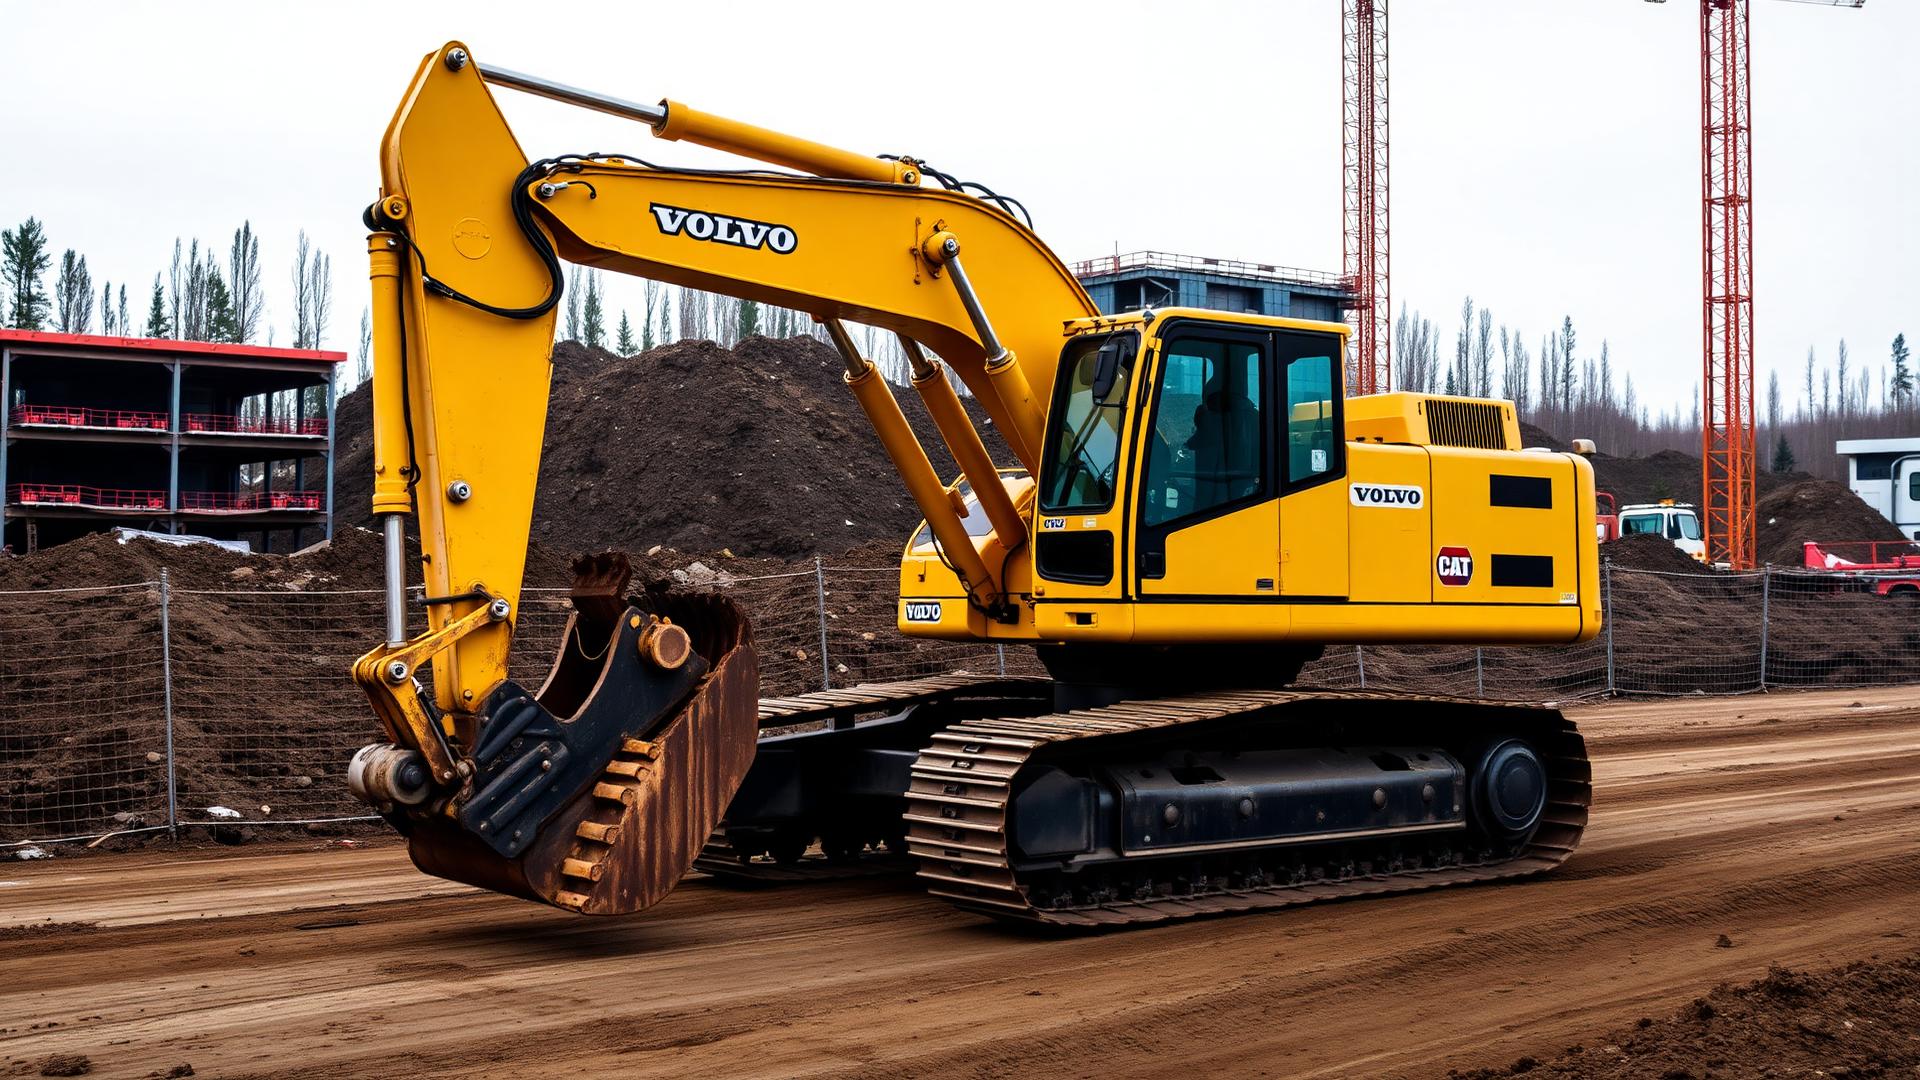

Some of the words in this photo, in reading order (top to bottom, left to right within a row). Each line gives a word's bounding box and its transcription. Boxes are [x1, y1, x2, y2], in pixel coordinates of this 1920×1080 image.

[651, 205, 797, 253] VOLVO
[1353, 487, 1421, 505] VOLVO
[1438, 555, 1471, 577] CAT
